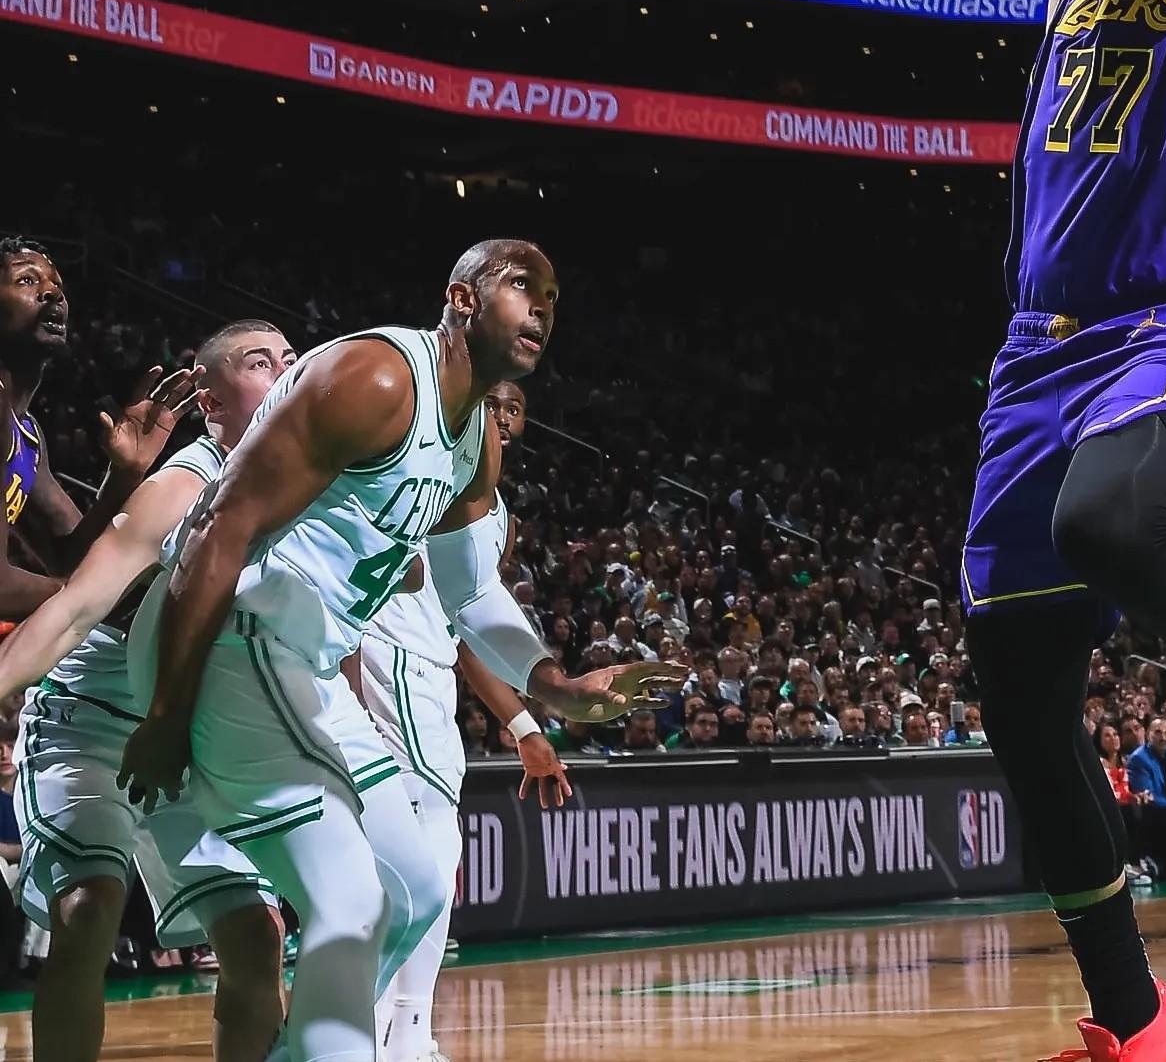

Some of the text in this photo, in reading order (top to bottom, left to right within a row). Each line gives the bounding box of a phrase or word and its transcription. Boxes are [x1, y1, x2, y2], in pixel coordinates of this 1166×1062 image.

[314, 46, 435, 95] TD GARDEN
[1045, 48, 1153, 153] 77
[765, 110, 877, 152] COMMAND
[881, 122, 908, 155] THE
[914, 126, 973, 158] BALL
[542, 795, 933, 899] WHERE FANS ALWAYS WIN.
